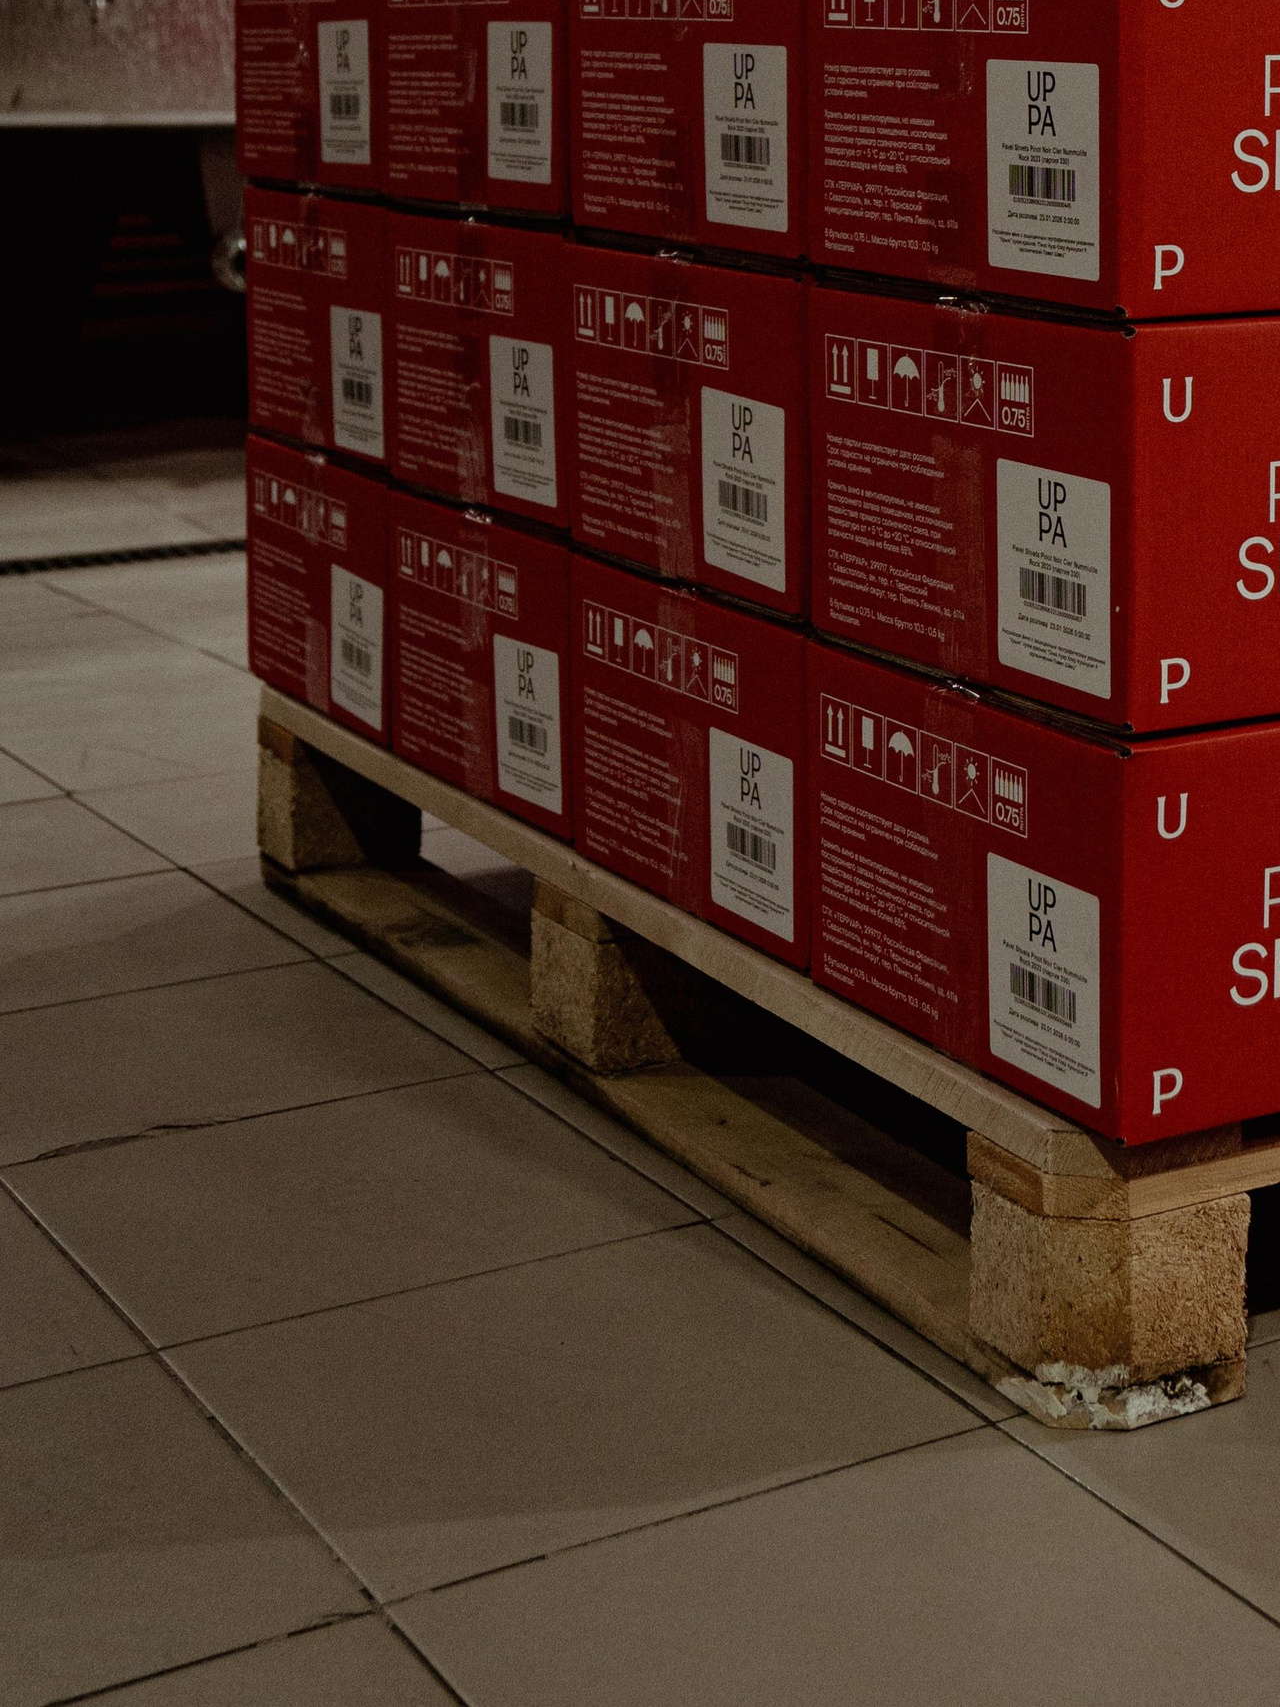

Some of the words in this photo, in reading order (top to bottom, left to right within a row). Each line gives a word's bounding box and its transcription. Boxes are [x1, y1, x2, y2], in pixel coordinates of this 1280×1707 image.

[997, 7, 1020, 25] 0.75
[510, 31, 527, 54] UP
[511, 56, 527, 80] PA
[733, 53, 755, 79] UP
[734, 82, 755, 109] PA
[1027, 71, 1055, 102] UP
[1028, 105, 1056, 136] PA
[1153, 244, 1185, 291] P
[512, 348, 529, 370] UP
[513, 373, 529, 397] PA
[1162, 376, 1194, 423] U
[732, 404, 752, 431] UP
[1002, 406, 1026, 428] 0.75
[732, 434, 753, 463] PA
[1037, 478, 1066, 511] UP
[1038, 512, 1067, 548] PA
[517, 648, 533, 673] UP
[517, 675, 535, 702] PA
[1159, 657, 1191, 705] P
[740, 748, 761, 779] UP
[741, 779, 761, 809] PA
[996, 802, 1019, 826] 0.75
[1157, 792, 1189, 840] U
[1028, 878, 1056, 914] UP
[883, 933, 914, 954] Российская
[1029, 914, 1057, 952] PA
[1152, 1067, 1184, 1116] P
